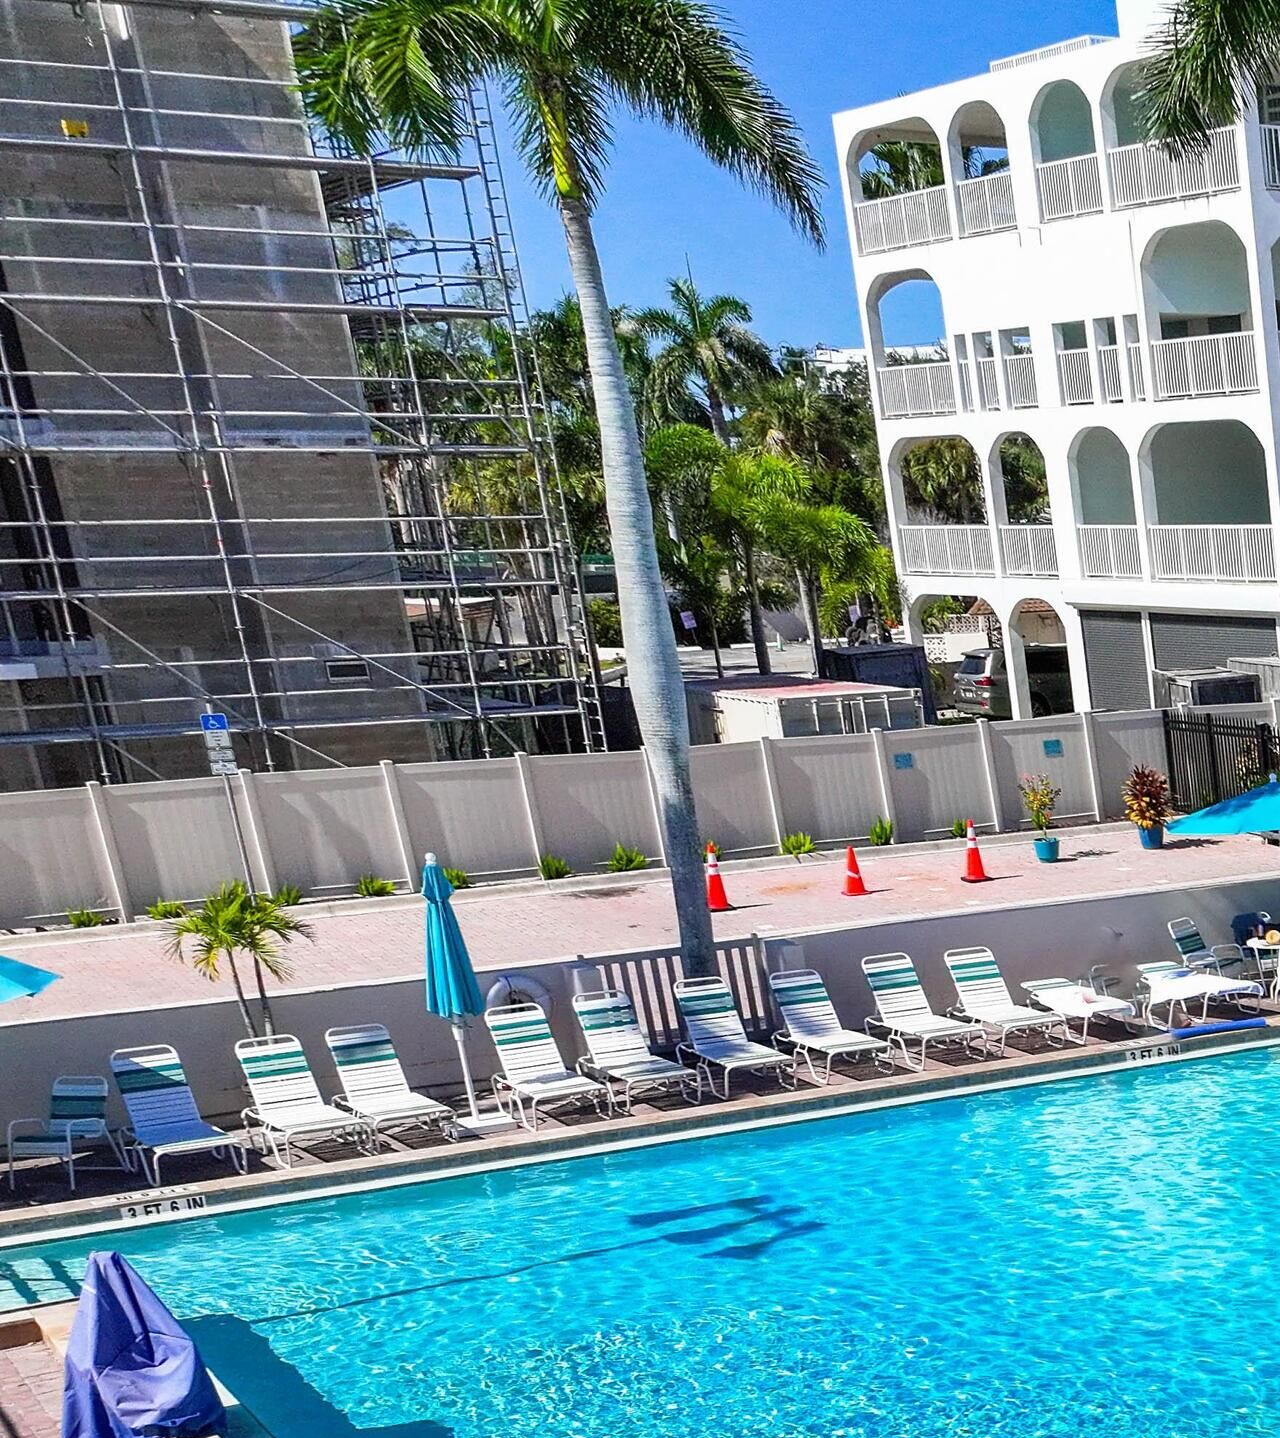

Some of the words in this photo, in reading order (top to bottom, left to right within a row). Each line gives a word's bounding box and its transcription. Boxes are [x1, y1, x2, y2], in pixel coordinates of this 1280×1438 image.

[1140, 1049, 1152, 1060] FT
[1167, 1045, 1179, 1055] IN
[143, 1203, 162, 1216] FT
[170, 1201, 180, 1212] 6
[186, 1197, 204, 1210] IN
